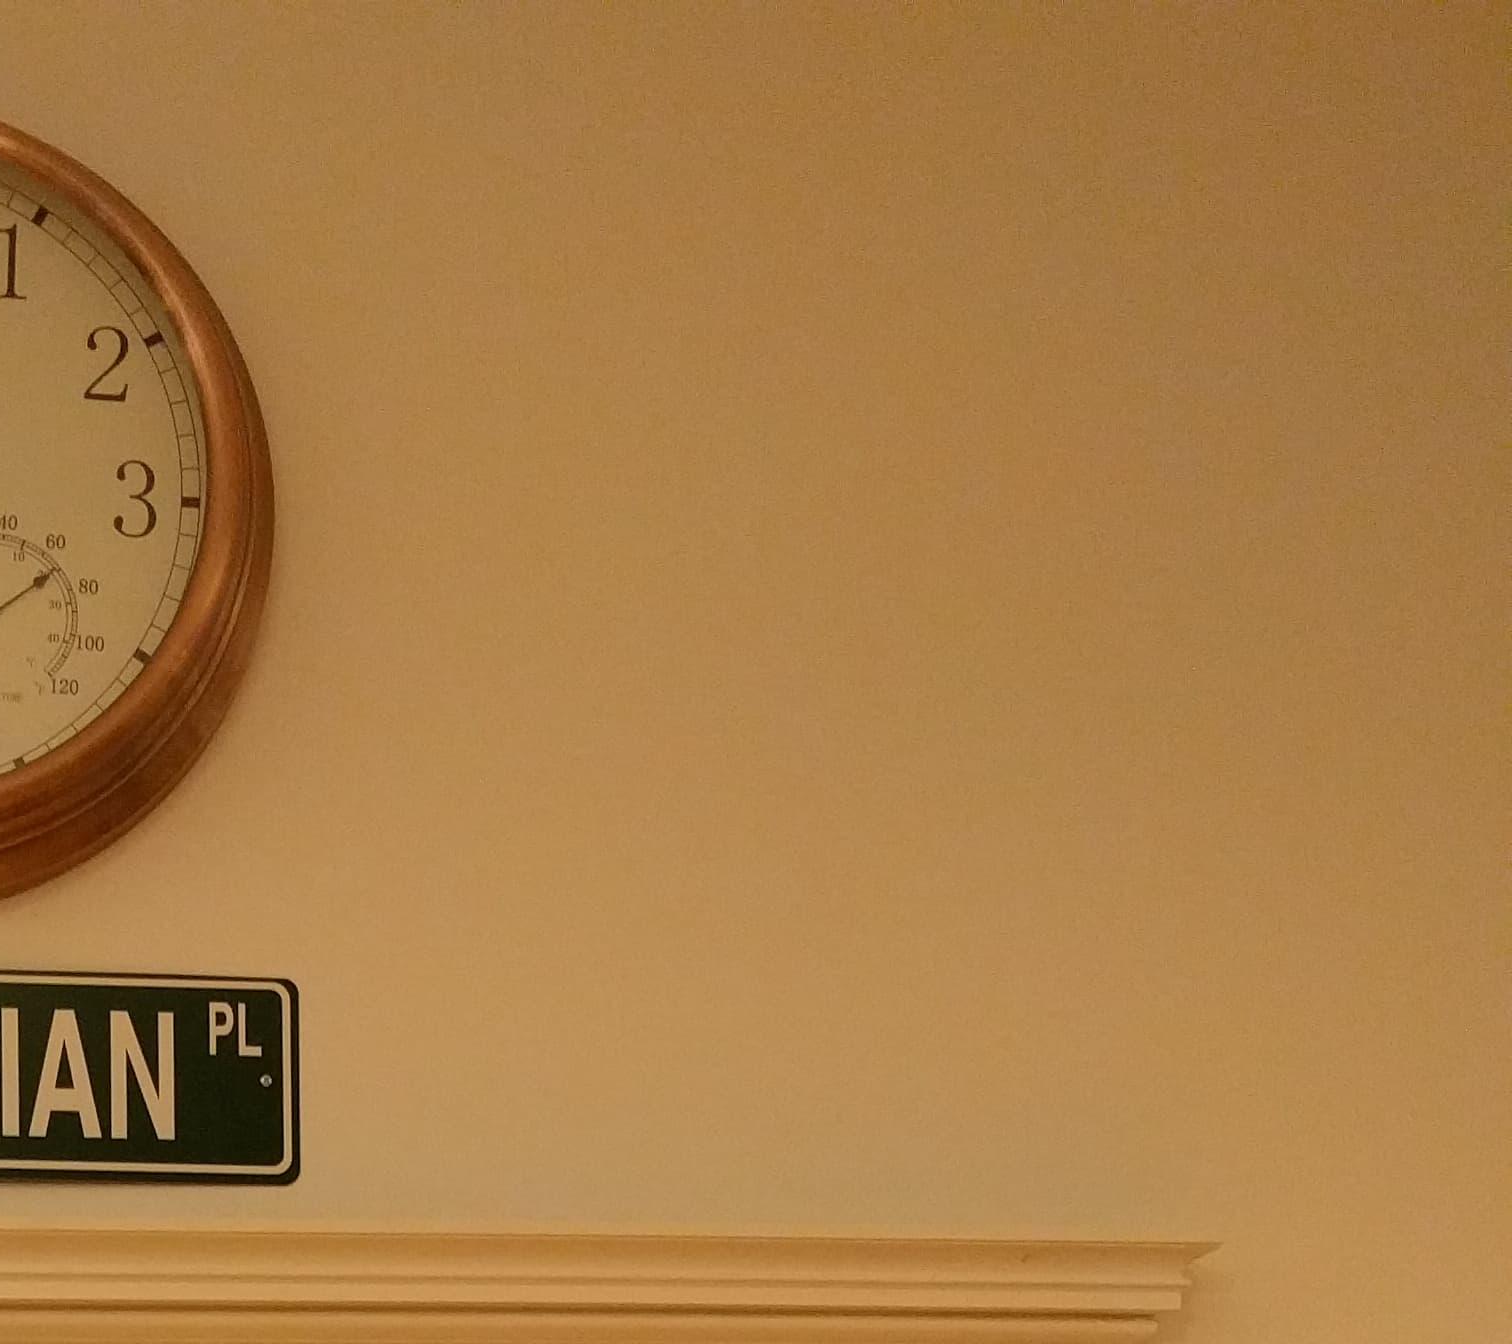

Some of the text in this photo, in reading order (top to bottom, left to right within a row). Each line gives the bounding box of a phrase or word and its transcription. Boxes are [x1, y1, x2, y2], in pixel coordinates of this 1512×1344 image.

[84, 325, 130, 402] 2
[114, 460, 157, 538] 3
[46, 534, 66, 550] 60
[79, 579, 99, 595] 80
[76, 635, 105, 652] 100
[50, 678, 79, 695] 120
[209, 1001, 262, 1057] PL
